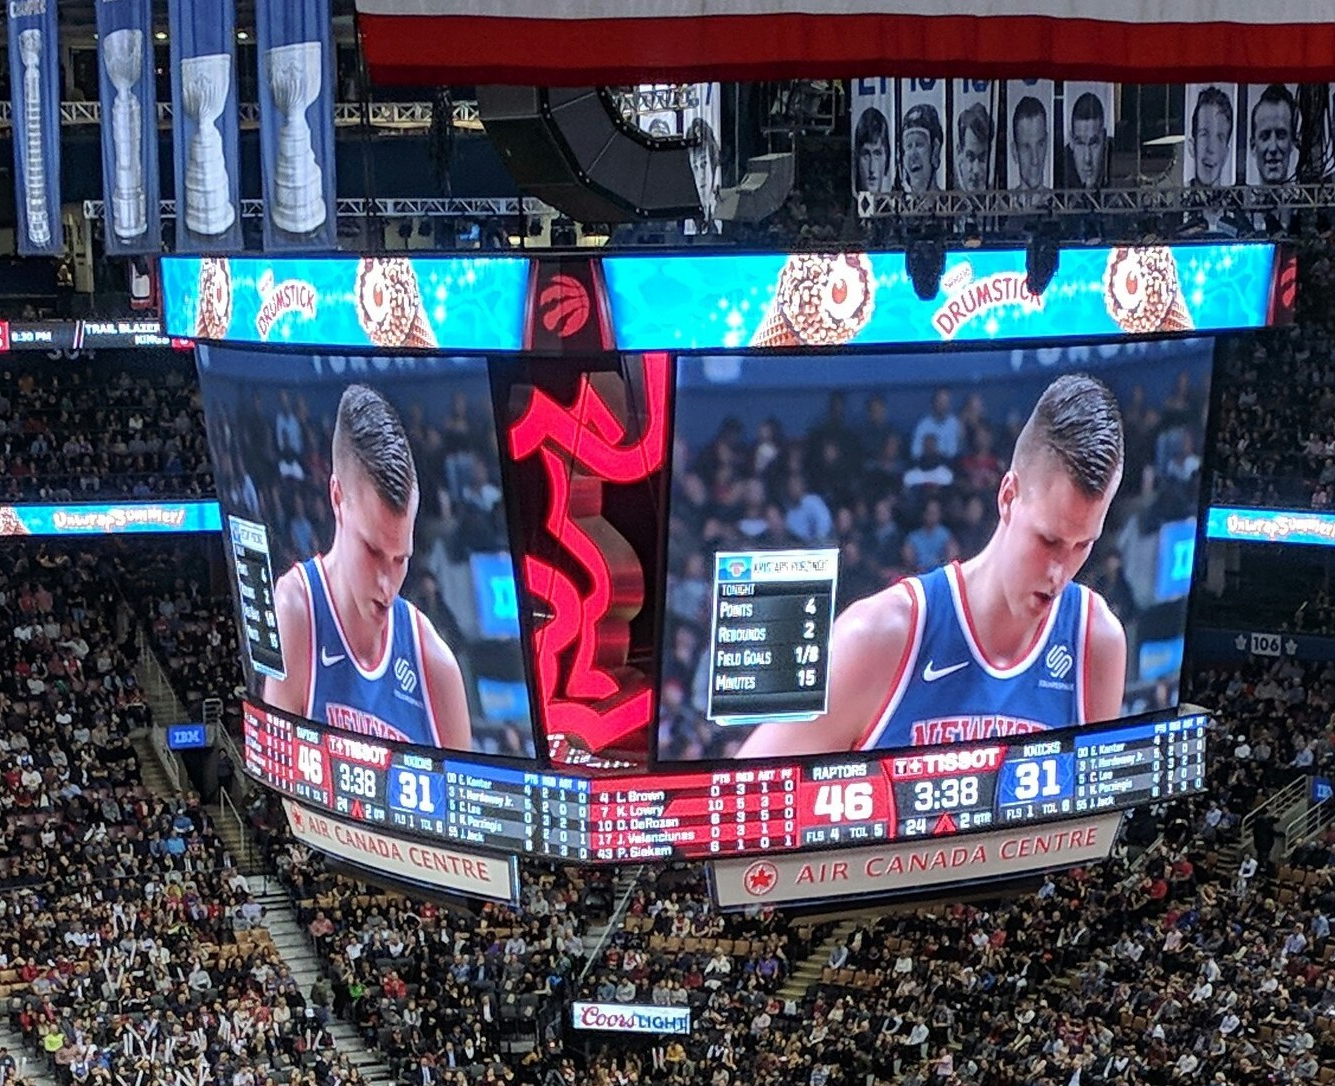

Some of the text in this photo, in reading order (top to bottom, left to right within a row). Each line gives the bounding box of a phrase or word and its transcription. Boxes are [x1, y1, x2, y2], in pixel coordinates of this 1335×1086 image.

[258, 284, 314, 335] DRUMSTICK
[805, 598, 816, 614] 4
[803, 622, 815, 638] 2
[1252, 636, 1280, 652] 106
[797, 670, 816, 686] 15
[174, 731, 198, 743] IBM
[1023, 742, 1061, 758] KNICKS
[298, 745, 323, 785] 46
[923, 748, 999, 773] TISSOT
[339, 763, 376, 797] 3:38
[813, 764, 867, 781] RAPTORS
[1015, 759, 1060, 800] 31
[1099, 770, 1113, 780] Lee
[398, 771, 436, 813] 31
[628, 791, 664, 802] Brown
[915, 777, 979, 811] 3:38
[629, 805, 664, 817] Lowry
[708, 799, 723, 811] 10
[814, 782, 873, 822] 46
[598, 817, 679, 831] 10 DeRozan
[906, 818, 926, 835] 24
[960, 814, 970, 828] 2
[598, 834, 612, 845] 17
[309, 817, 491, 882] AIR CANADA CENTRE
[795, 827, 1098, 885] AIR CANADA CENTRE
[581, 1006, 688, 1033] Coors LIGHT
